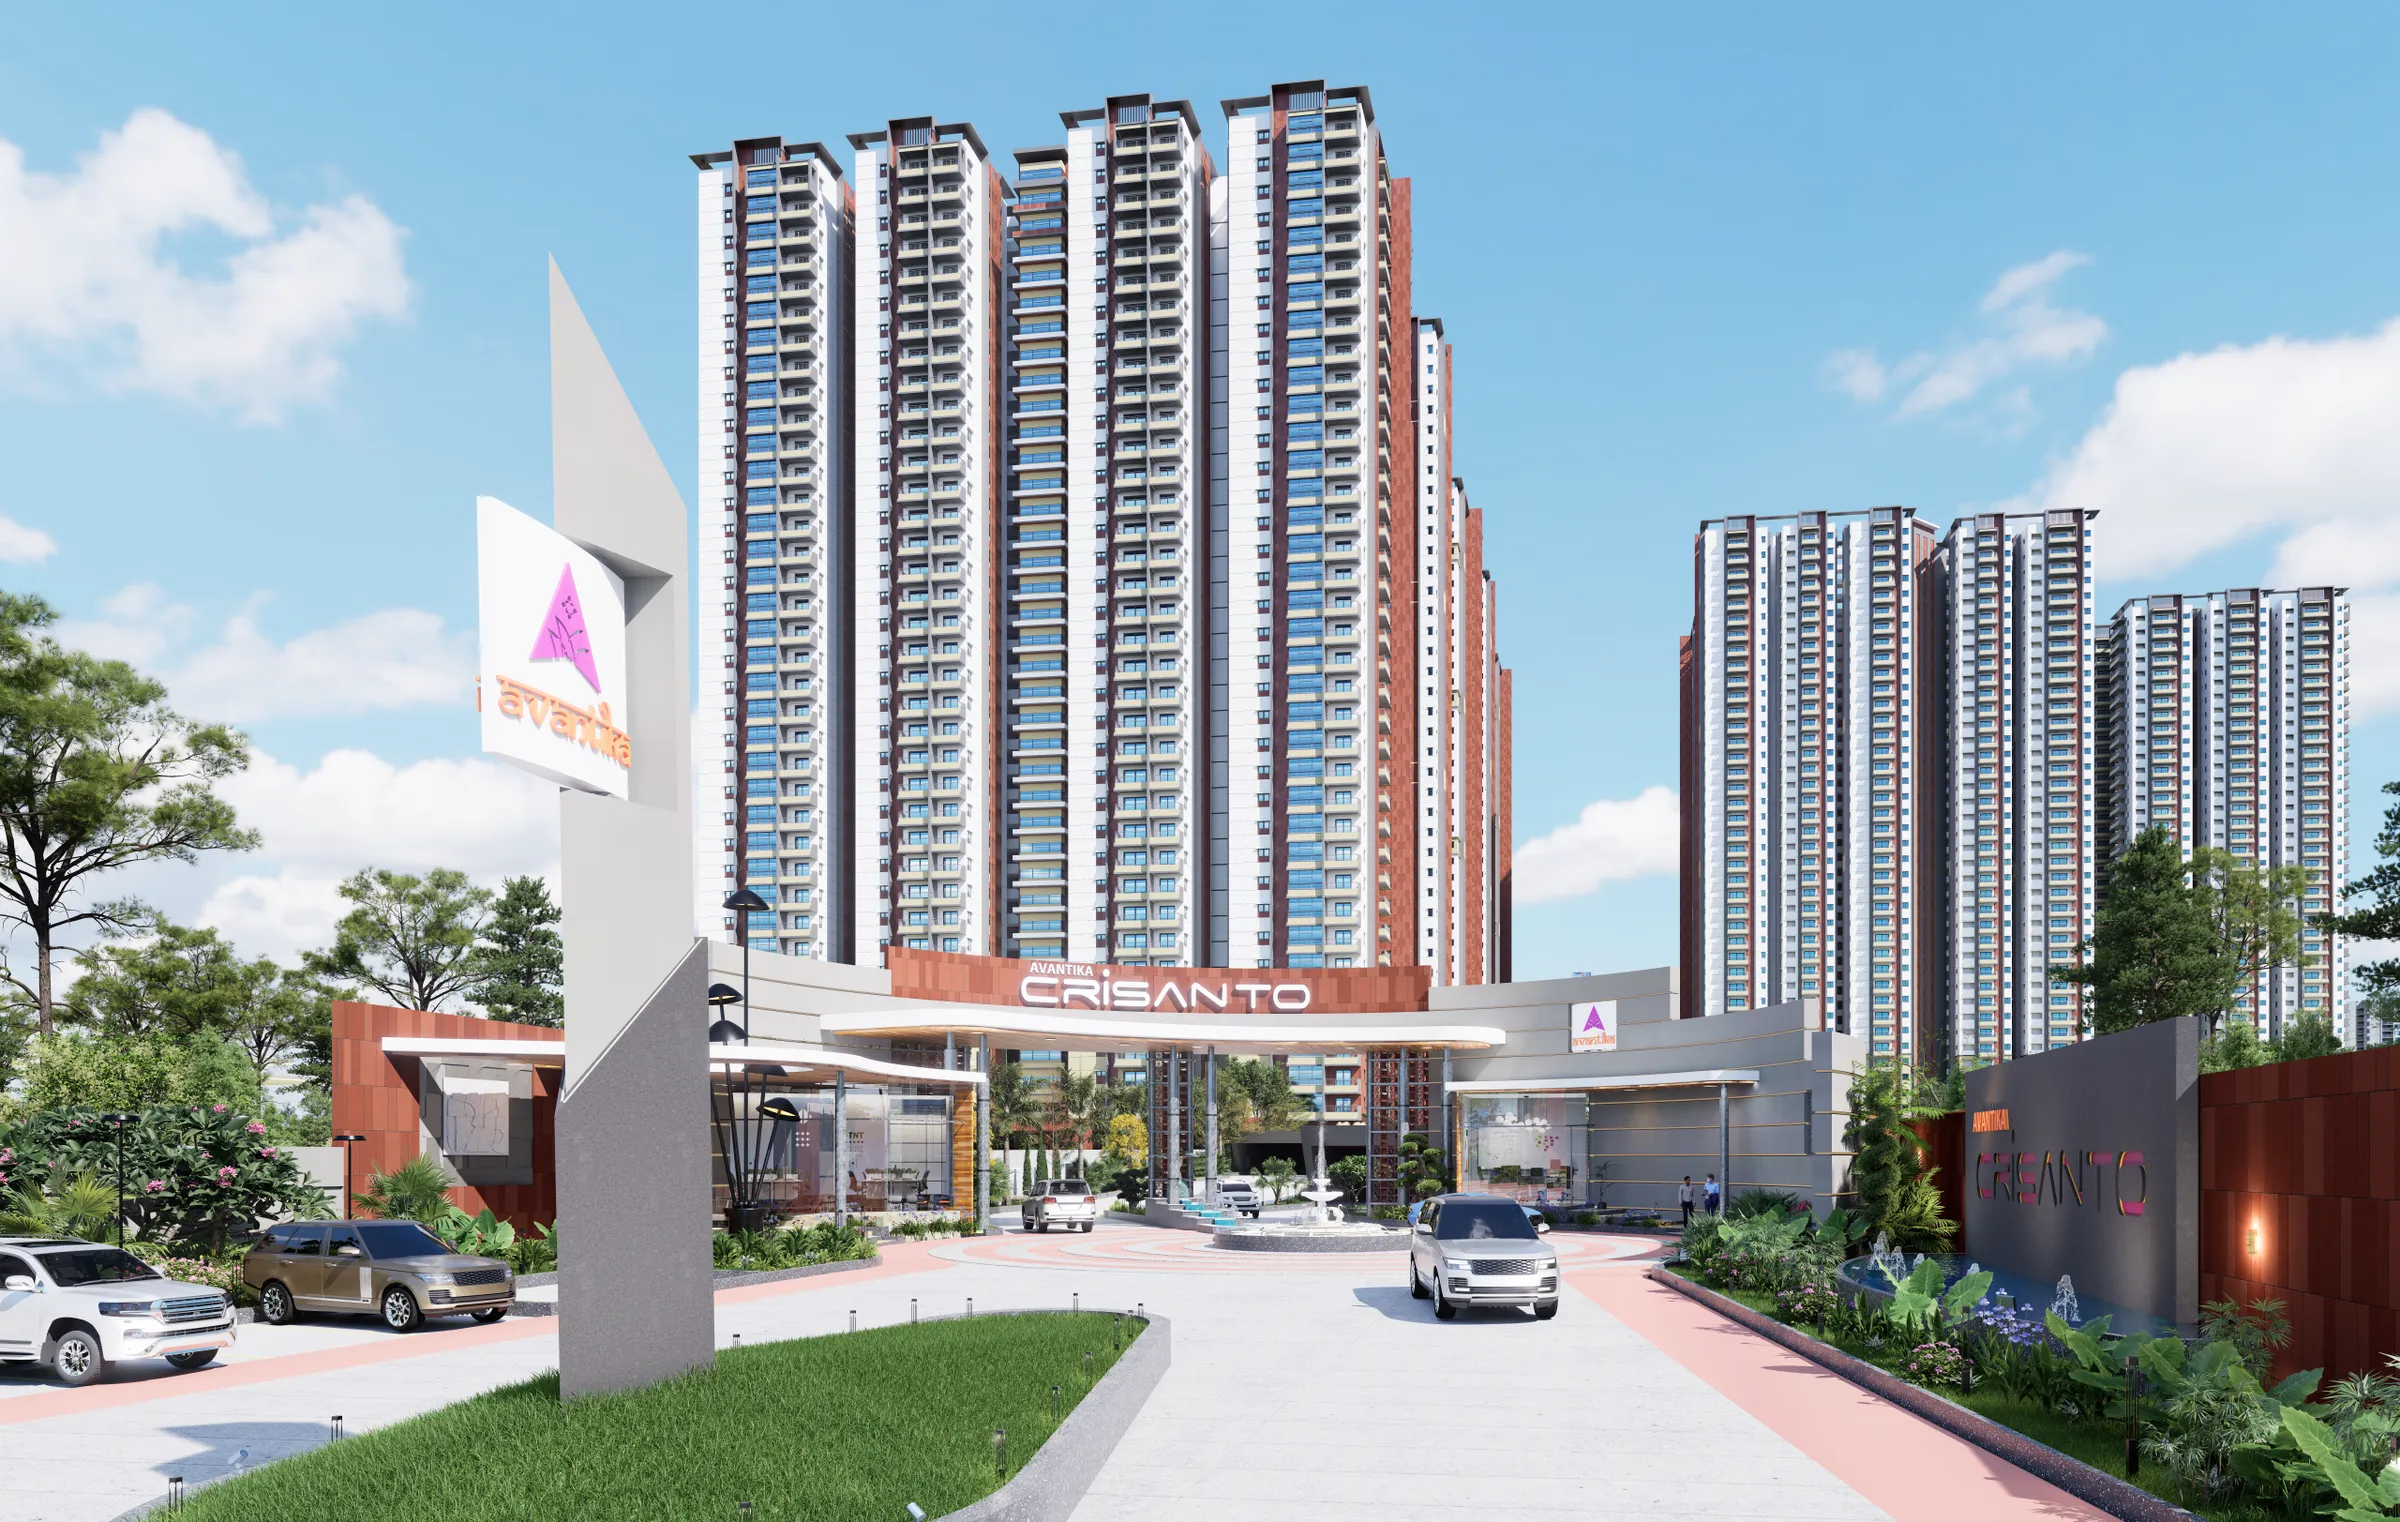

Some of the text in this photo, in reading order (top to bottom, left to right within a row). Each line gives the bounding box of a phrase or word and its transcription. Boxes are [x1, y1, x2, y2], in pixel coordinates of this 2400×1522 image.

[1029, 961, 1094, 977] AVANTIKA
[1572, 1031, 1616, 1047] avantika
[1972, 1109, 2010, 1133] AVANTIKA
